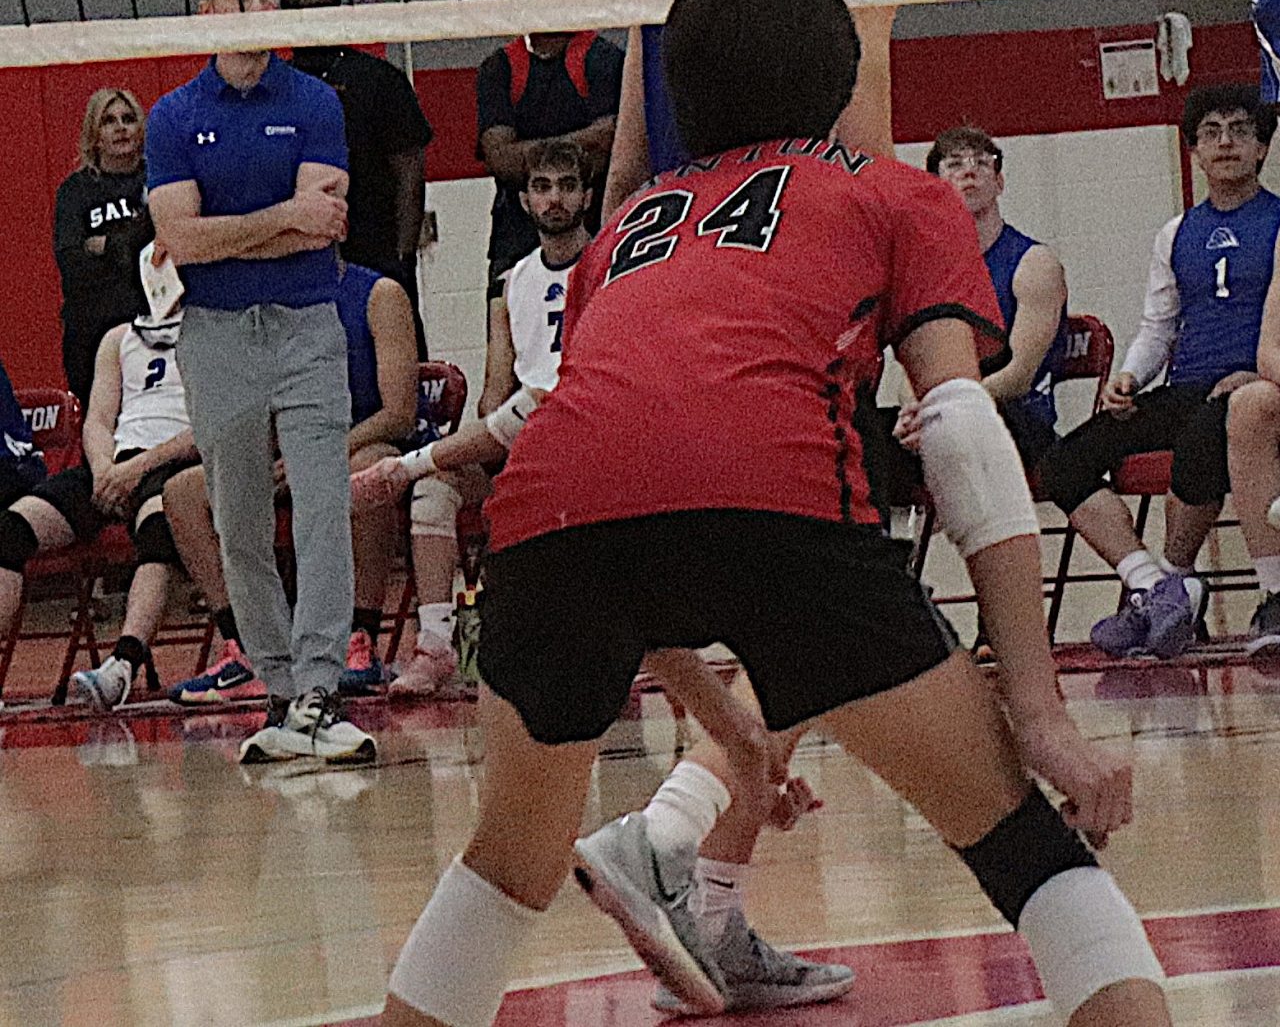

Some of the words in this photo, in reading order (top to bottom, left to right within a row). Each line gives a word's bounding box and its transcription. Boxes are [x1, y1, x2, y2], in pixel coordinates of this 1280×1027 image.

[90, 198, 139, 229] SAL
[601, 164, 792, 290] 24
[1214, 256, 1230, 298] 1
